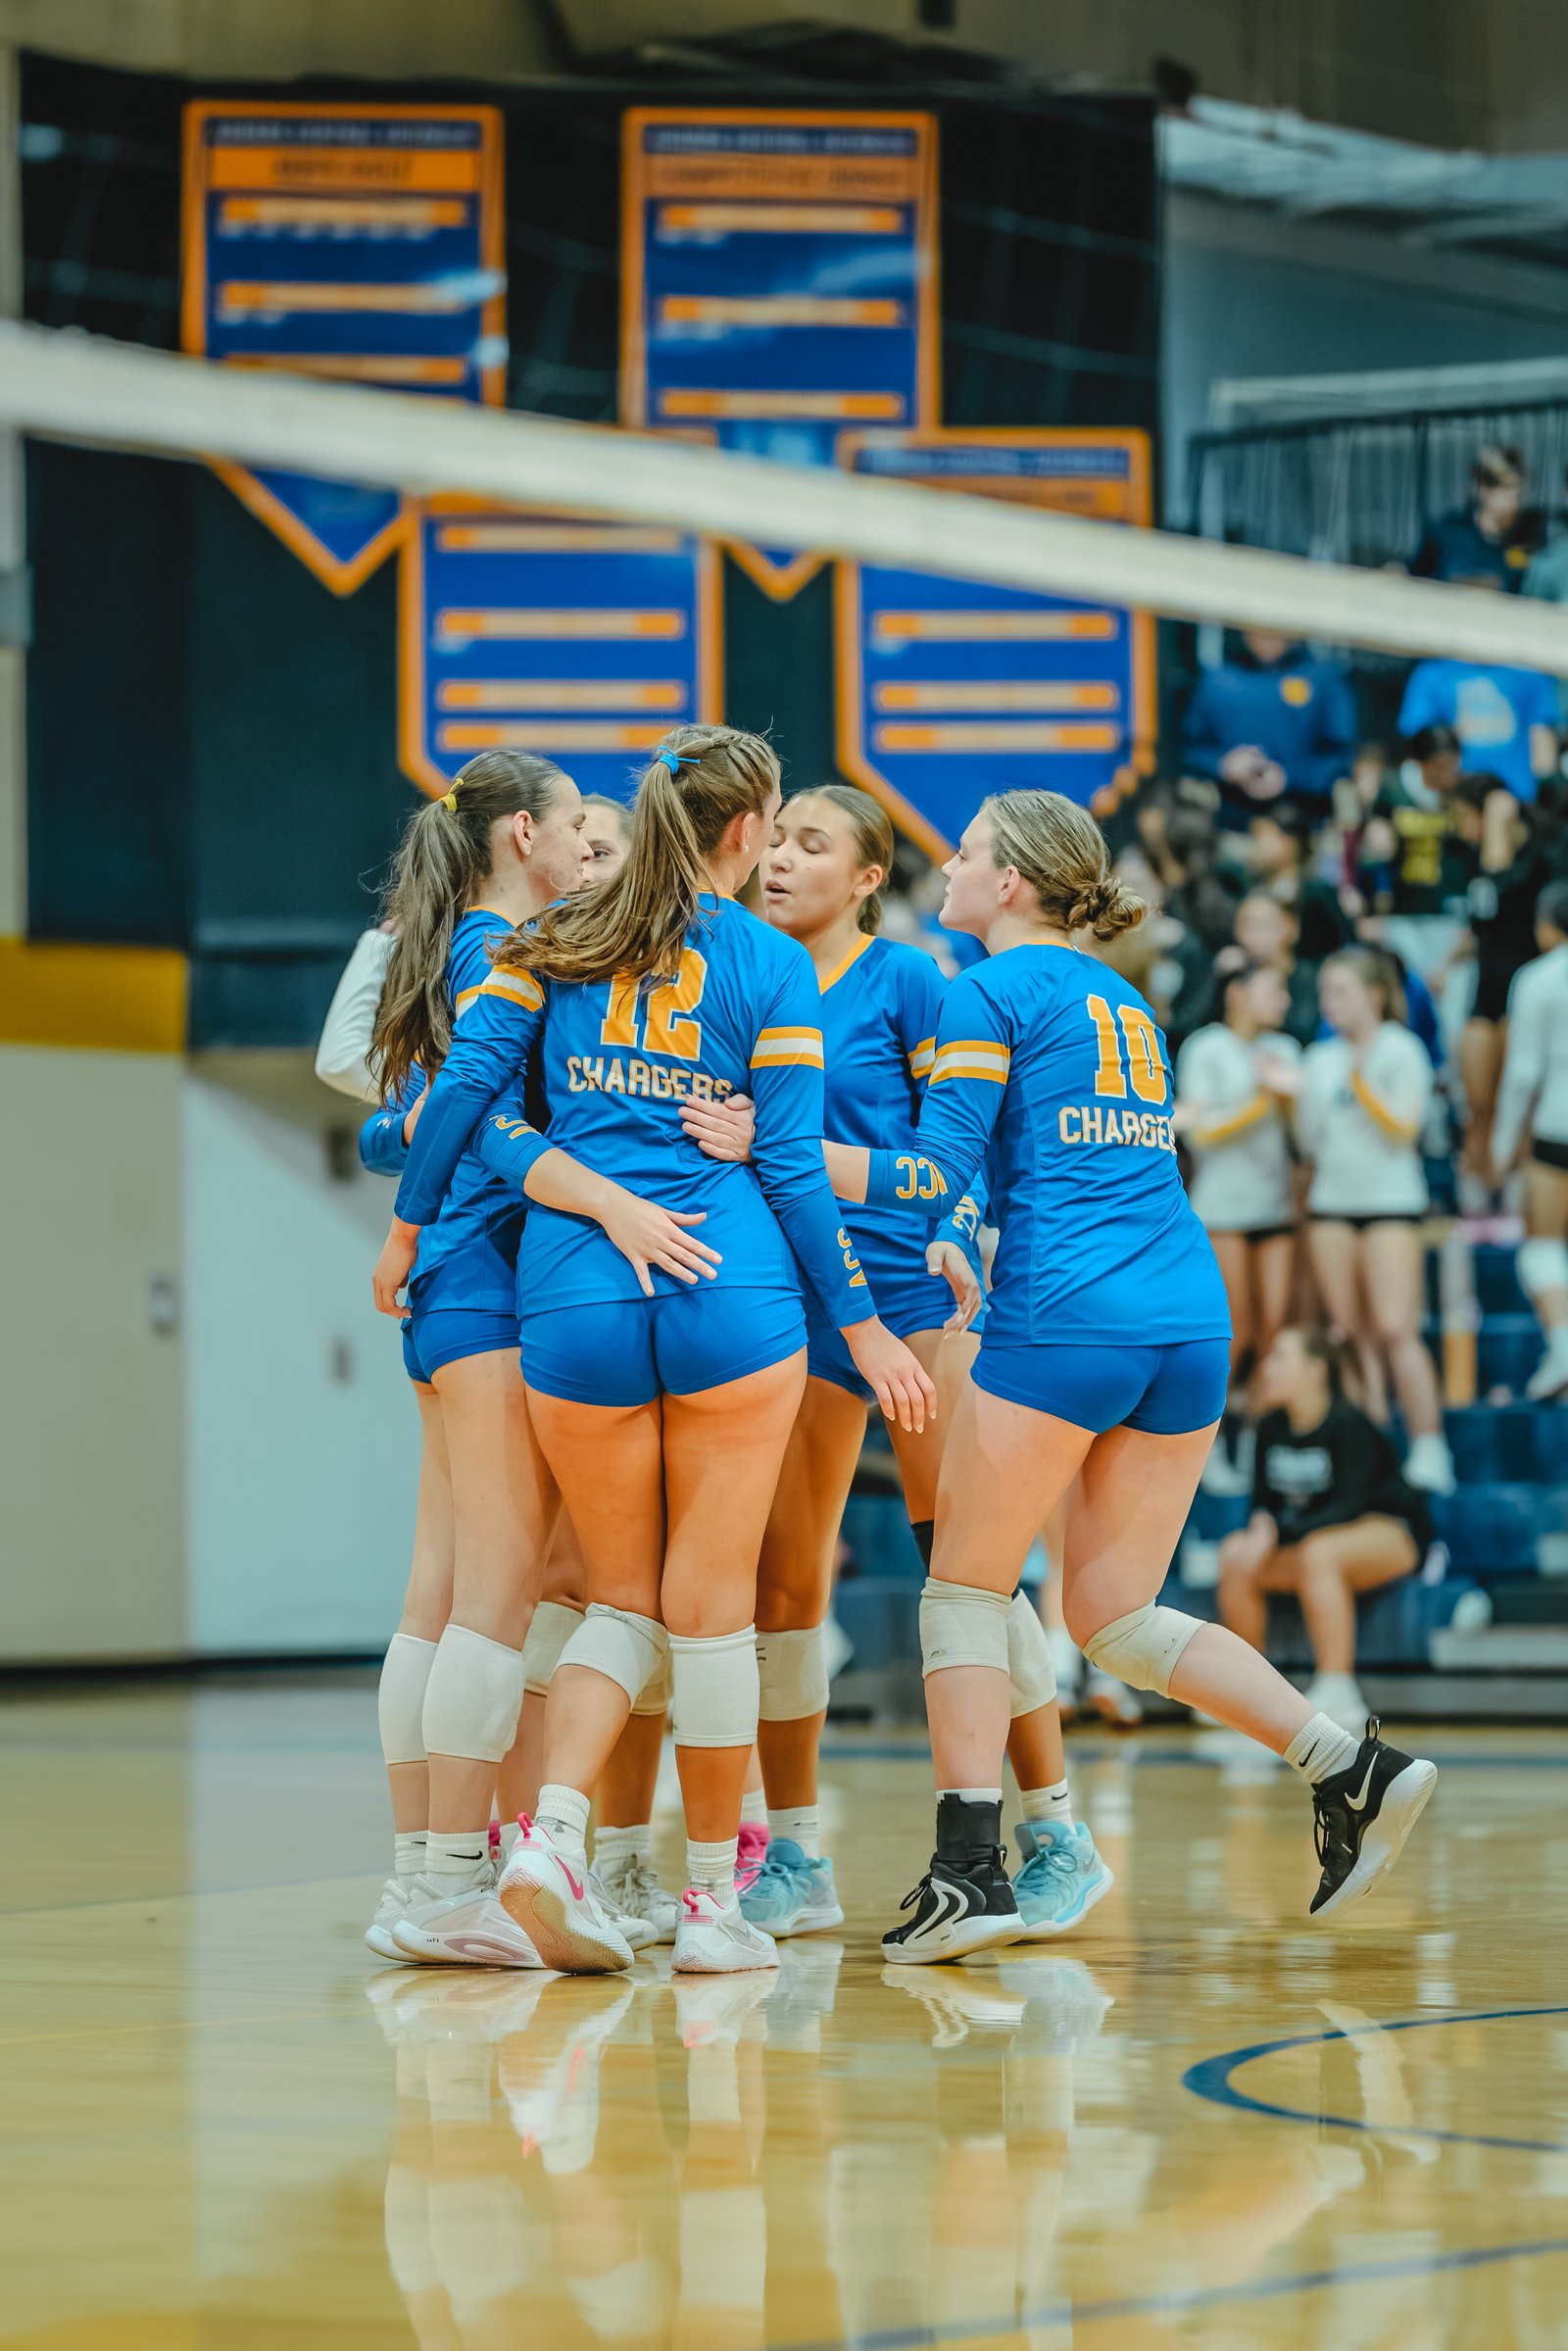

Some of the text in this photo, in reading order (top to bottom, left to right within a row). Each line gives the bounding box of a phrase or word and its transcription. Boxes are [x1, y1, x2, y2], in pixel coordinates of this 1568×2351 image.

[600, 946, 708, 1062] 12
[1086, 993, 1167, 1106] 10
[566, 1055, 733, 1103] CHARGERS
